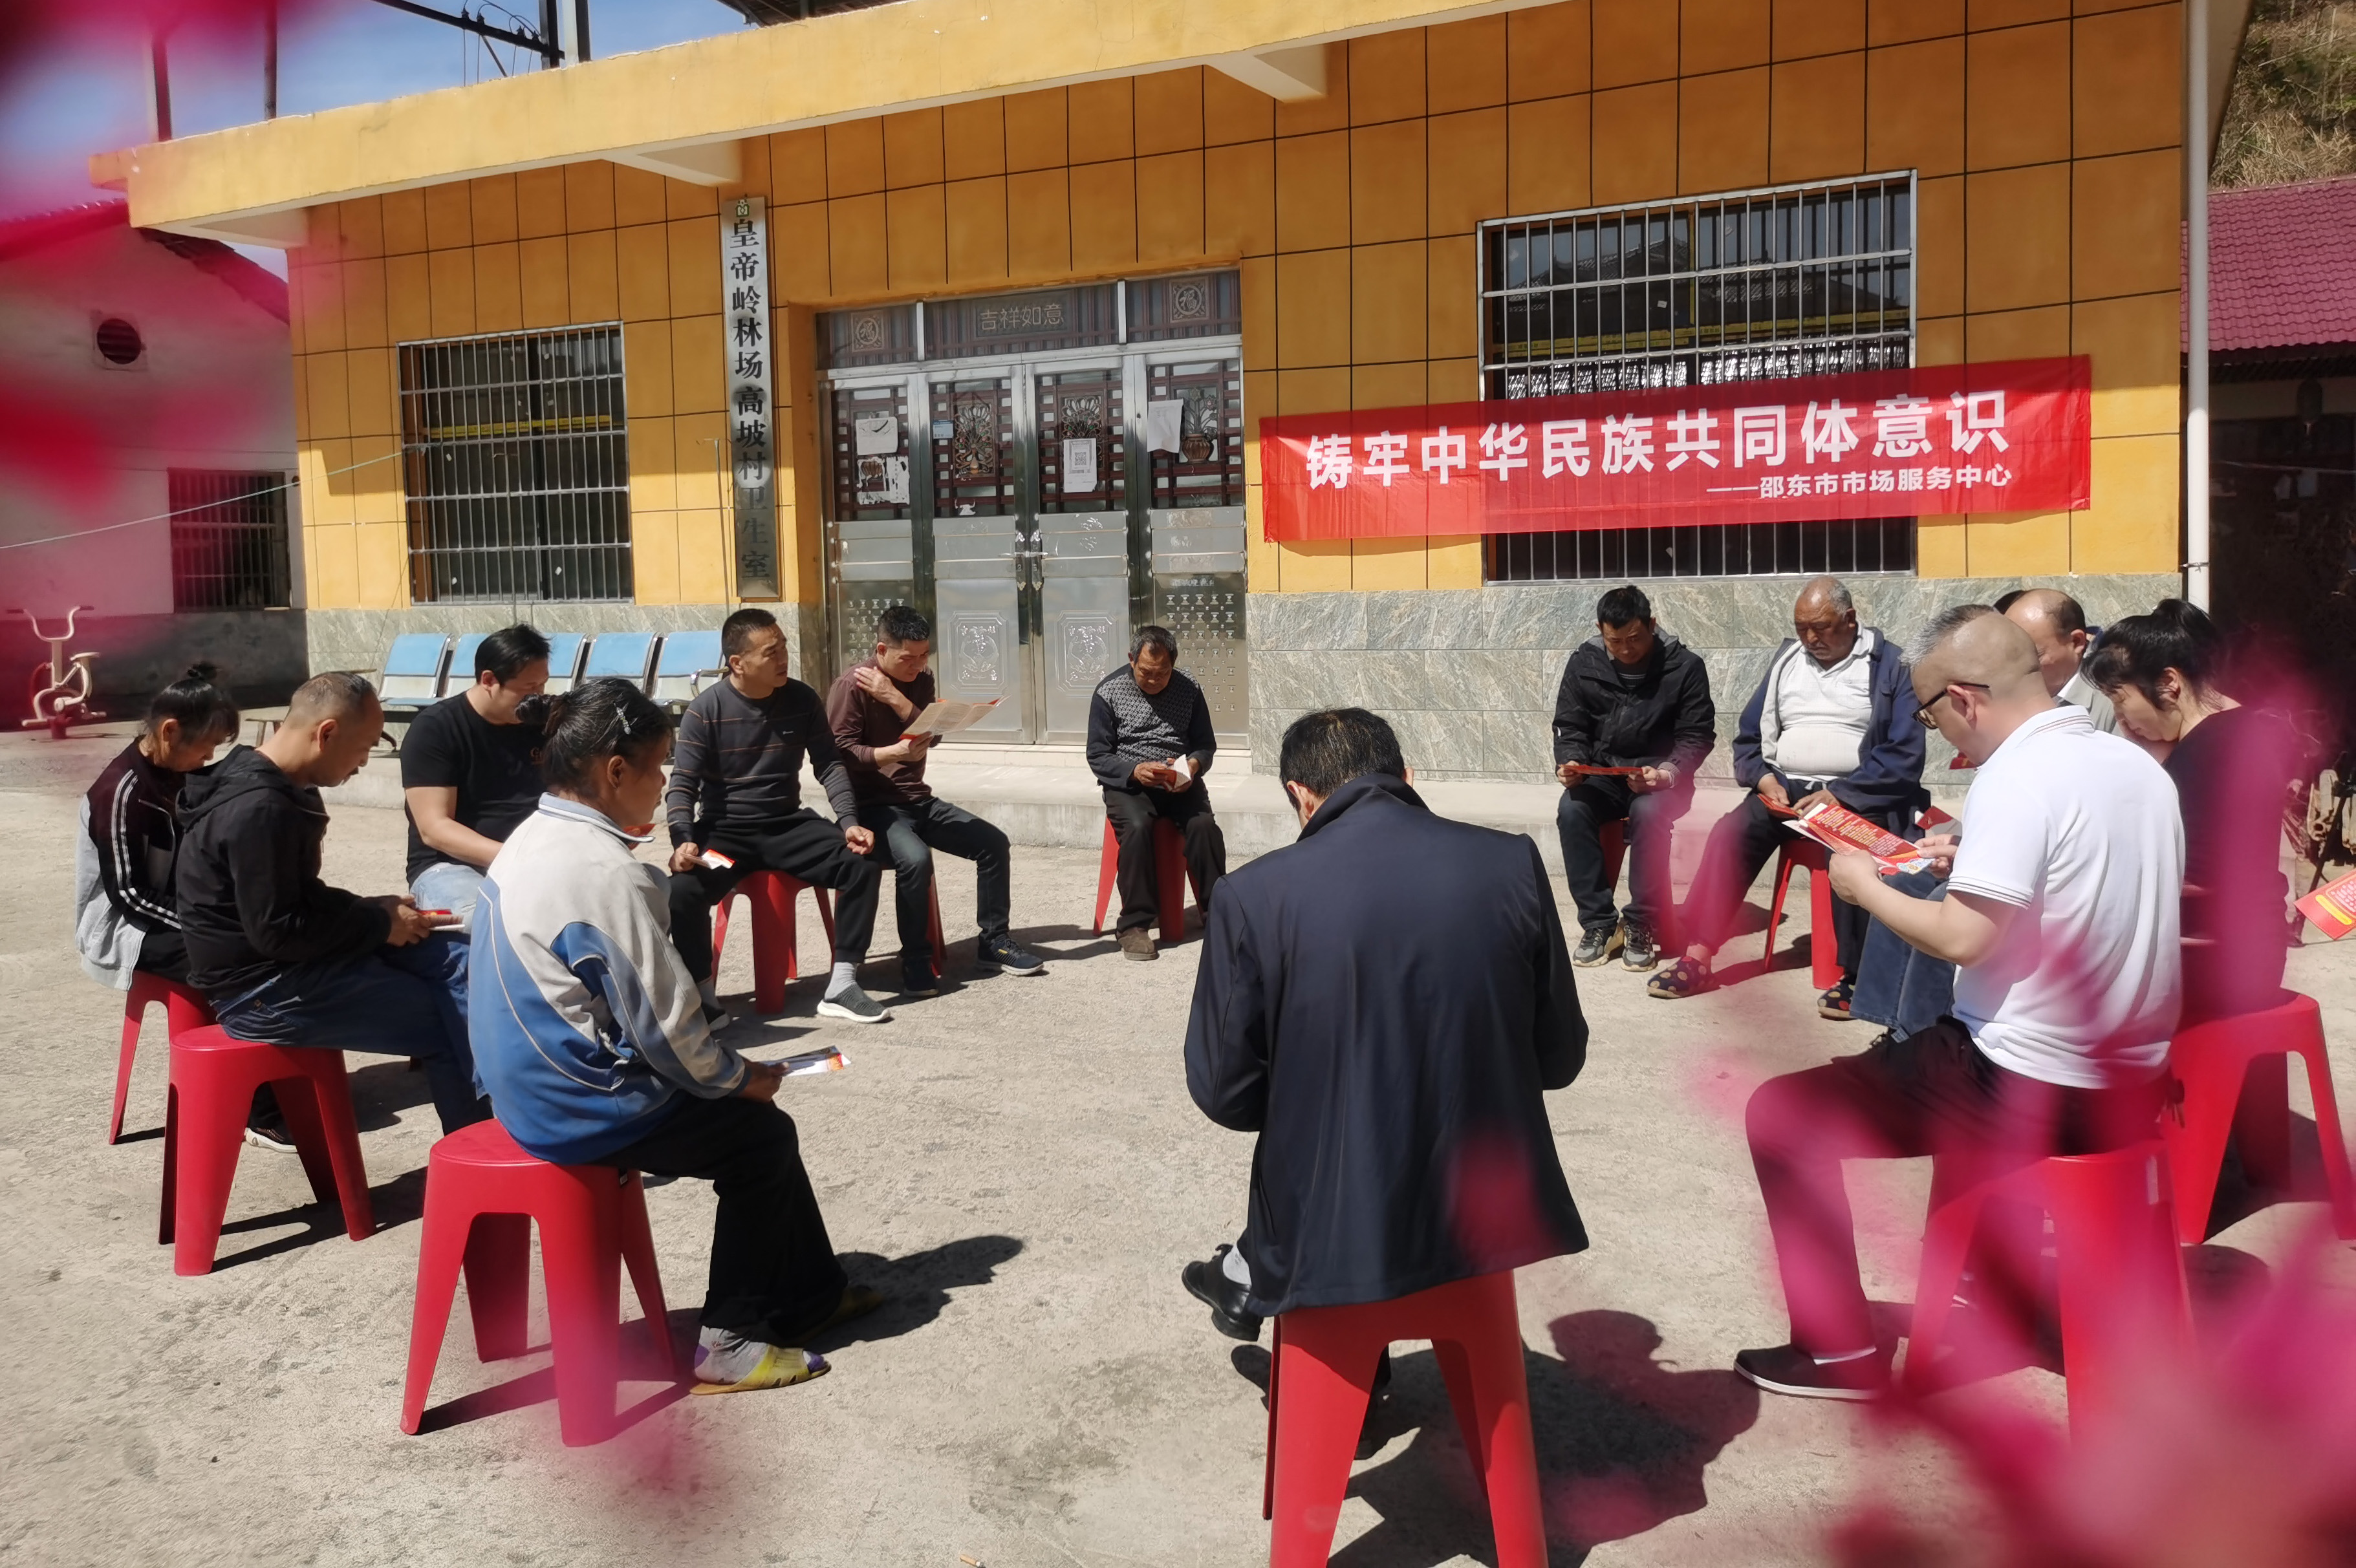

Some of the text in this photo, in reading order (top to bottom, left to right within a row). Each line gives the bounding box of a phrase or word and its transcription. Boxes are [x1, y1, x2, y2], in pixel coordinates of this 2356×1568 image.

[980, 303, 1064, 330] 吉祥如意
[729, 219, 770, 579] 皇帝岭林场高坡村卫生室
[1307, 390, 2009, 490] 铸牢中华民族共同体意识
